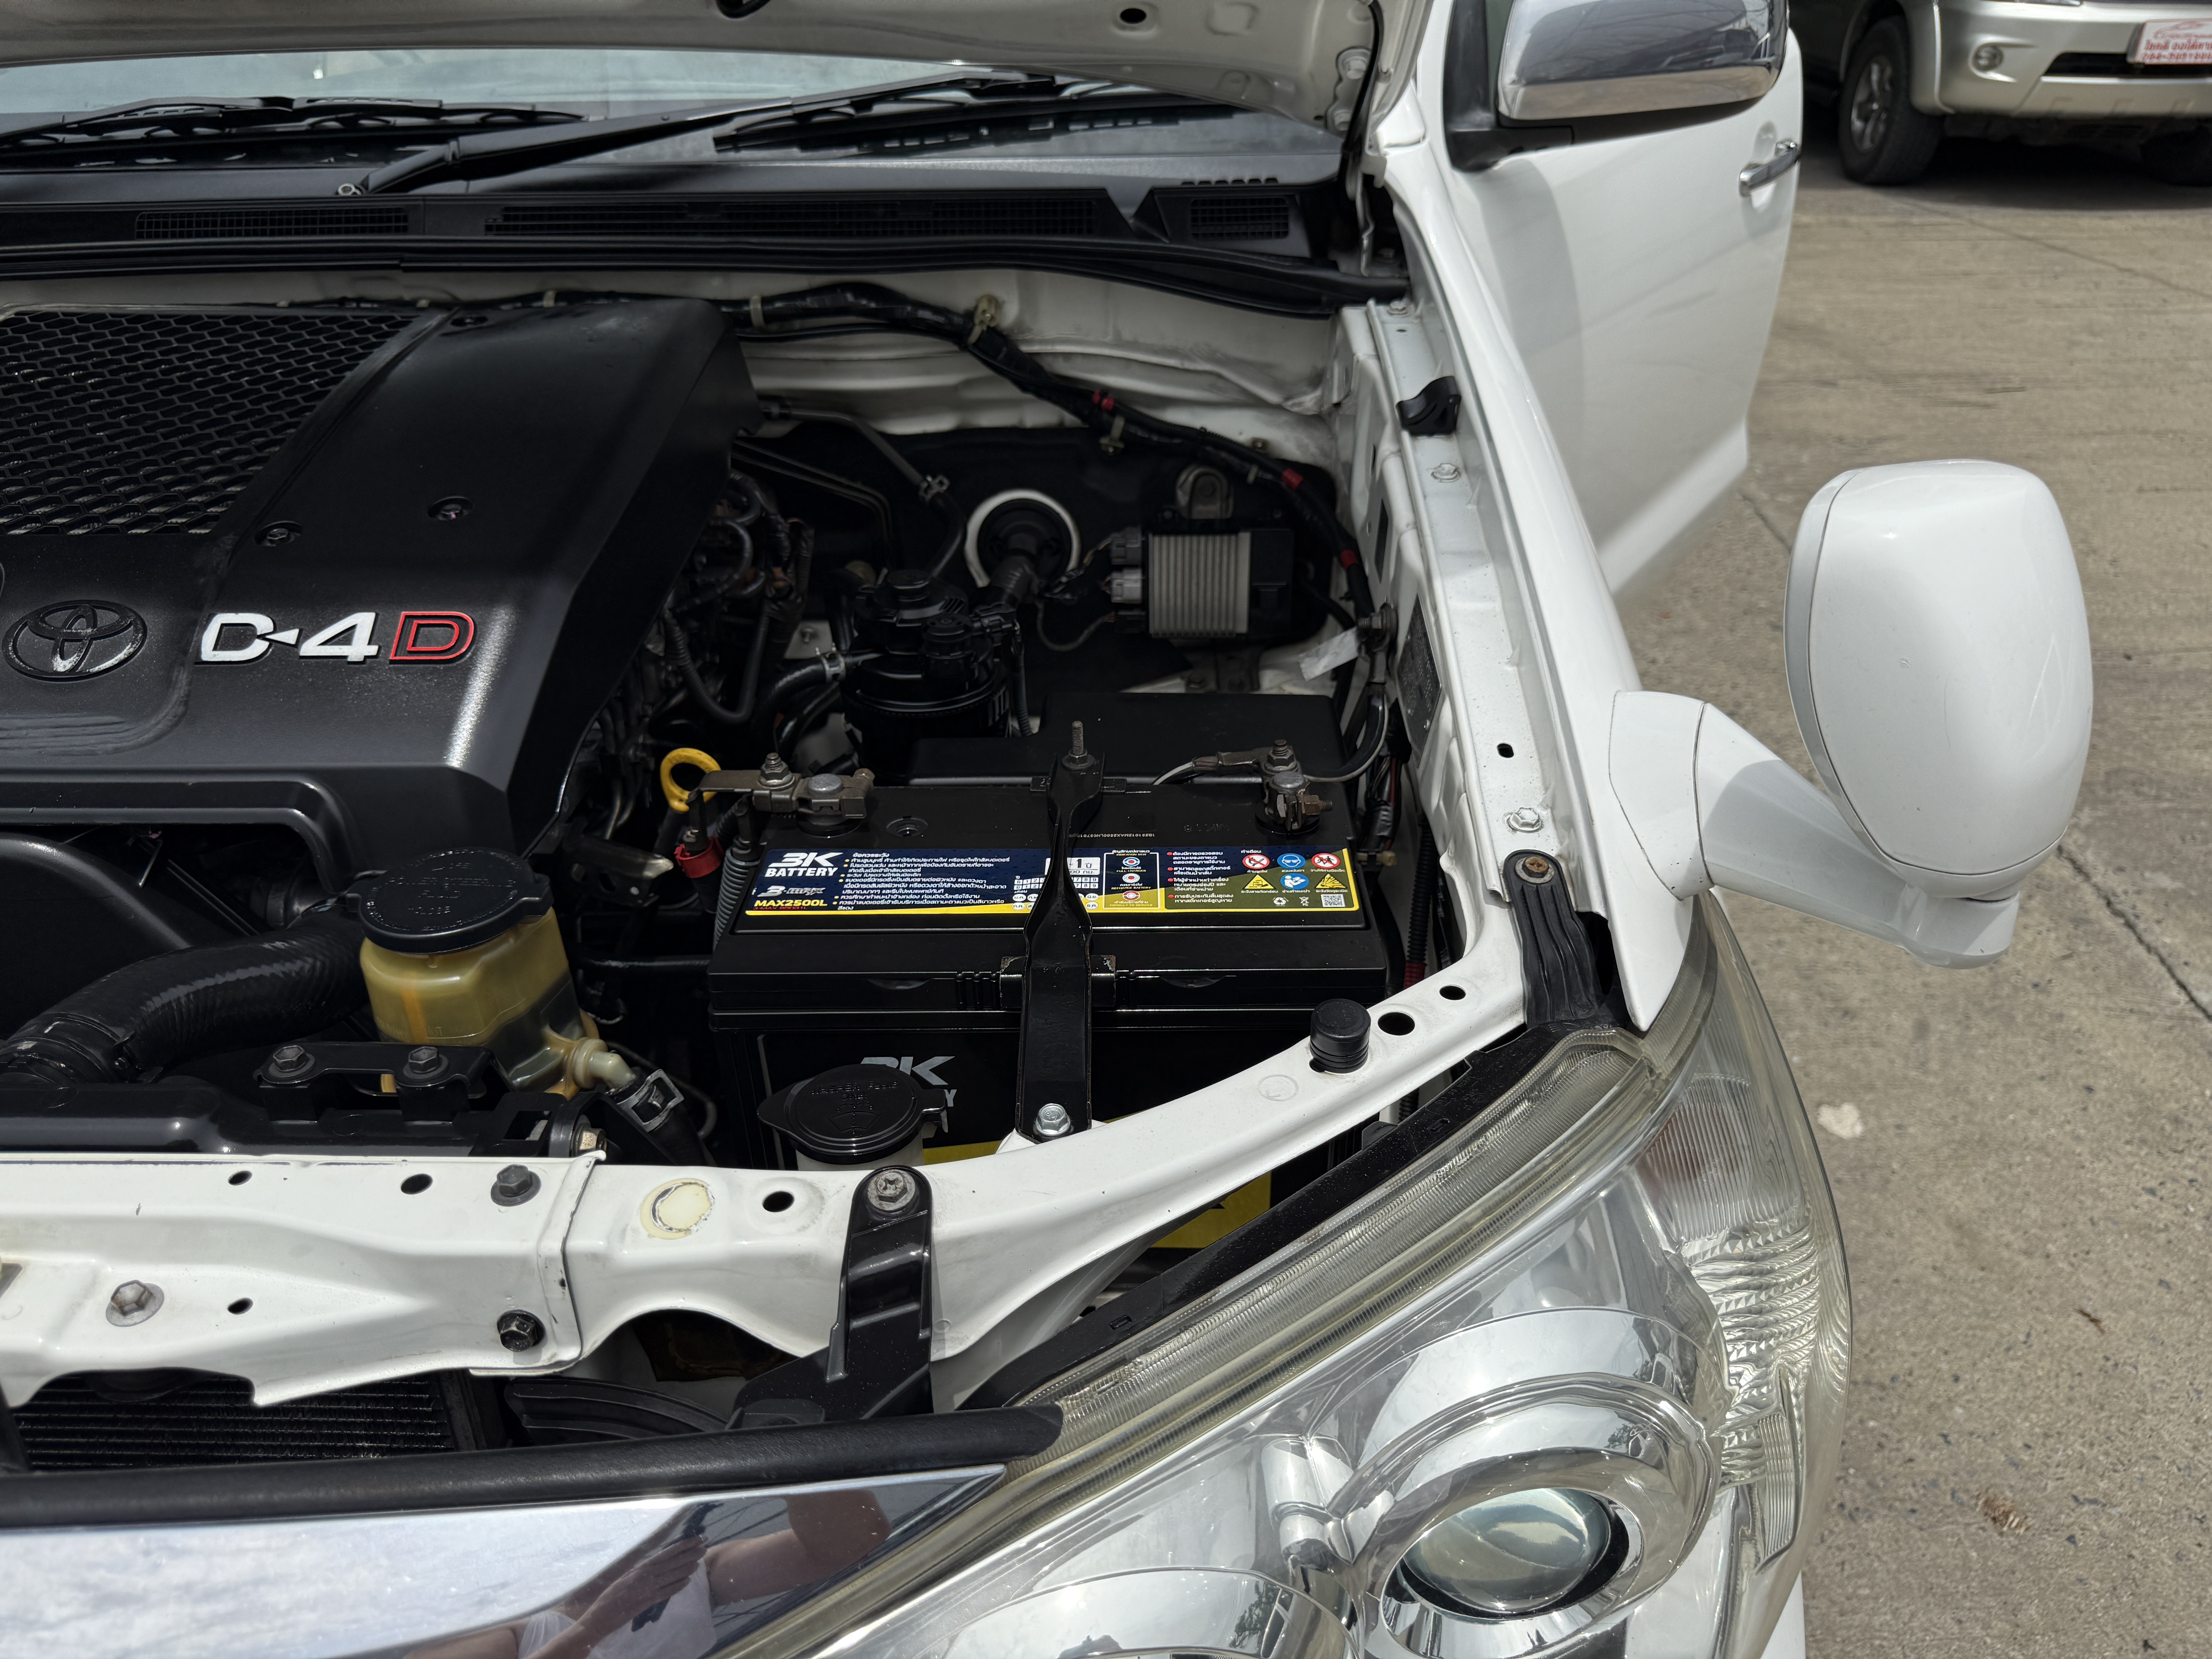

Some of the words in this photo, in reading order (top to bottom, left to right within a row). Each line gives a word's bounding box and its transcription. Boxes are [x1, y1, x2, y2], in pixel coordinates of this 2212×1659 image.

[199, 611, 475, 662] D-4D
[768, 852, 843, 867] 3K
[765, 867, 838, 878] BATTERY
